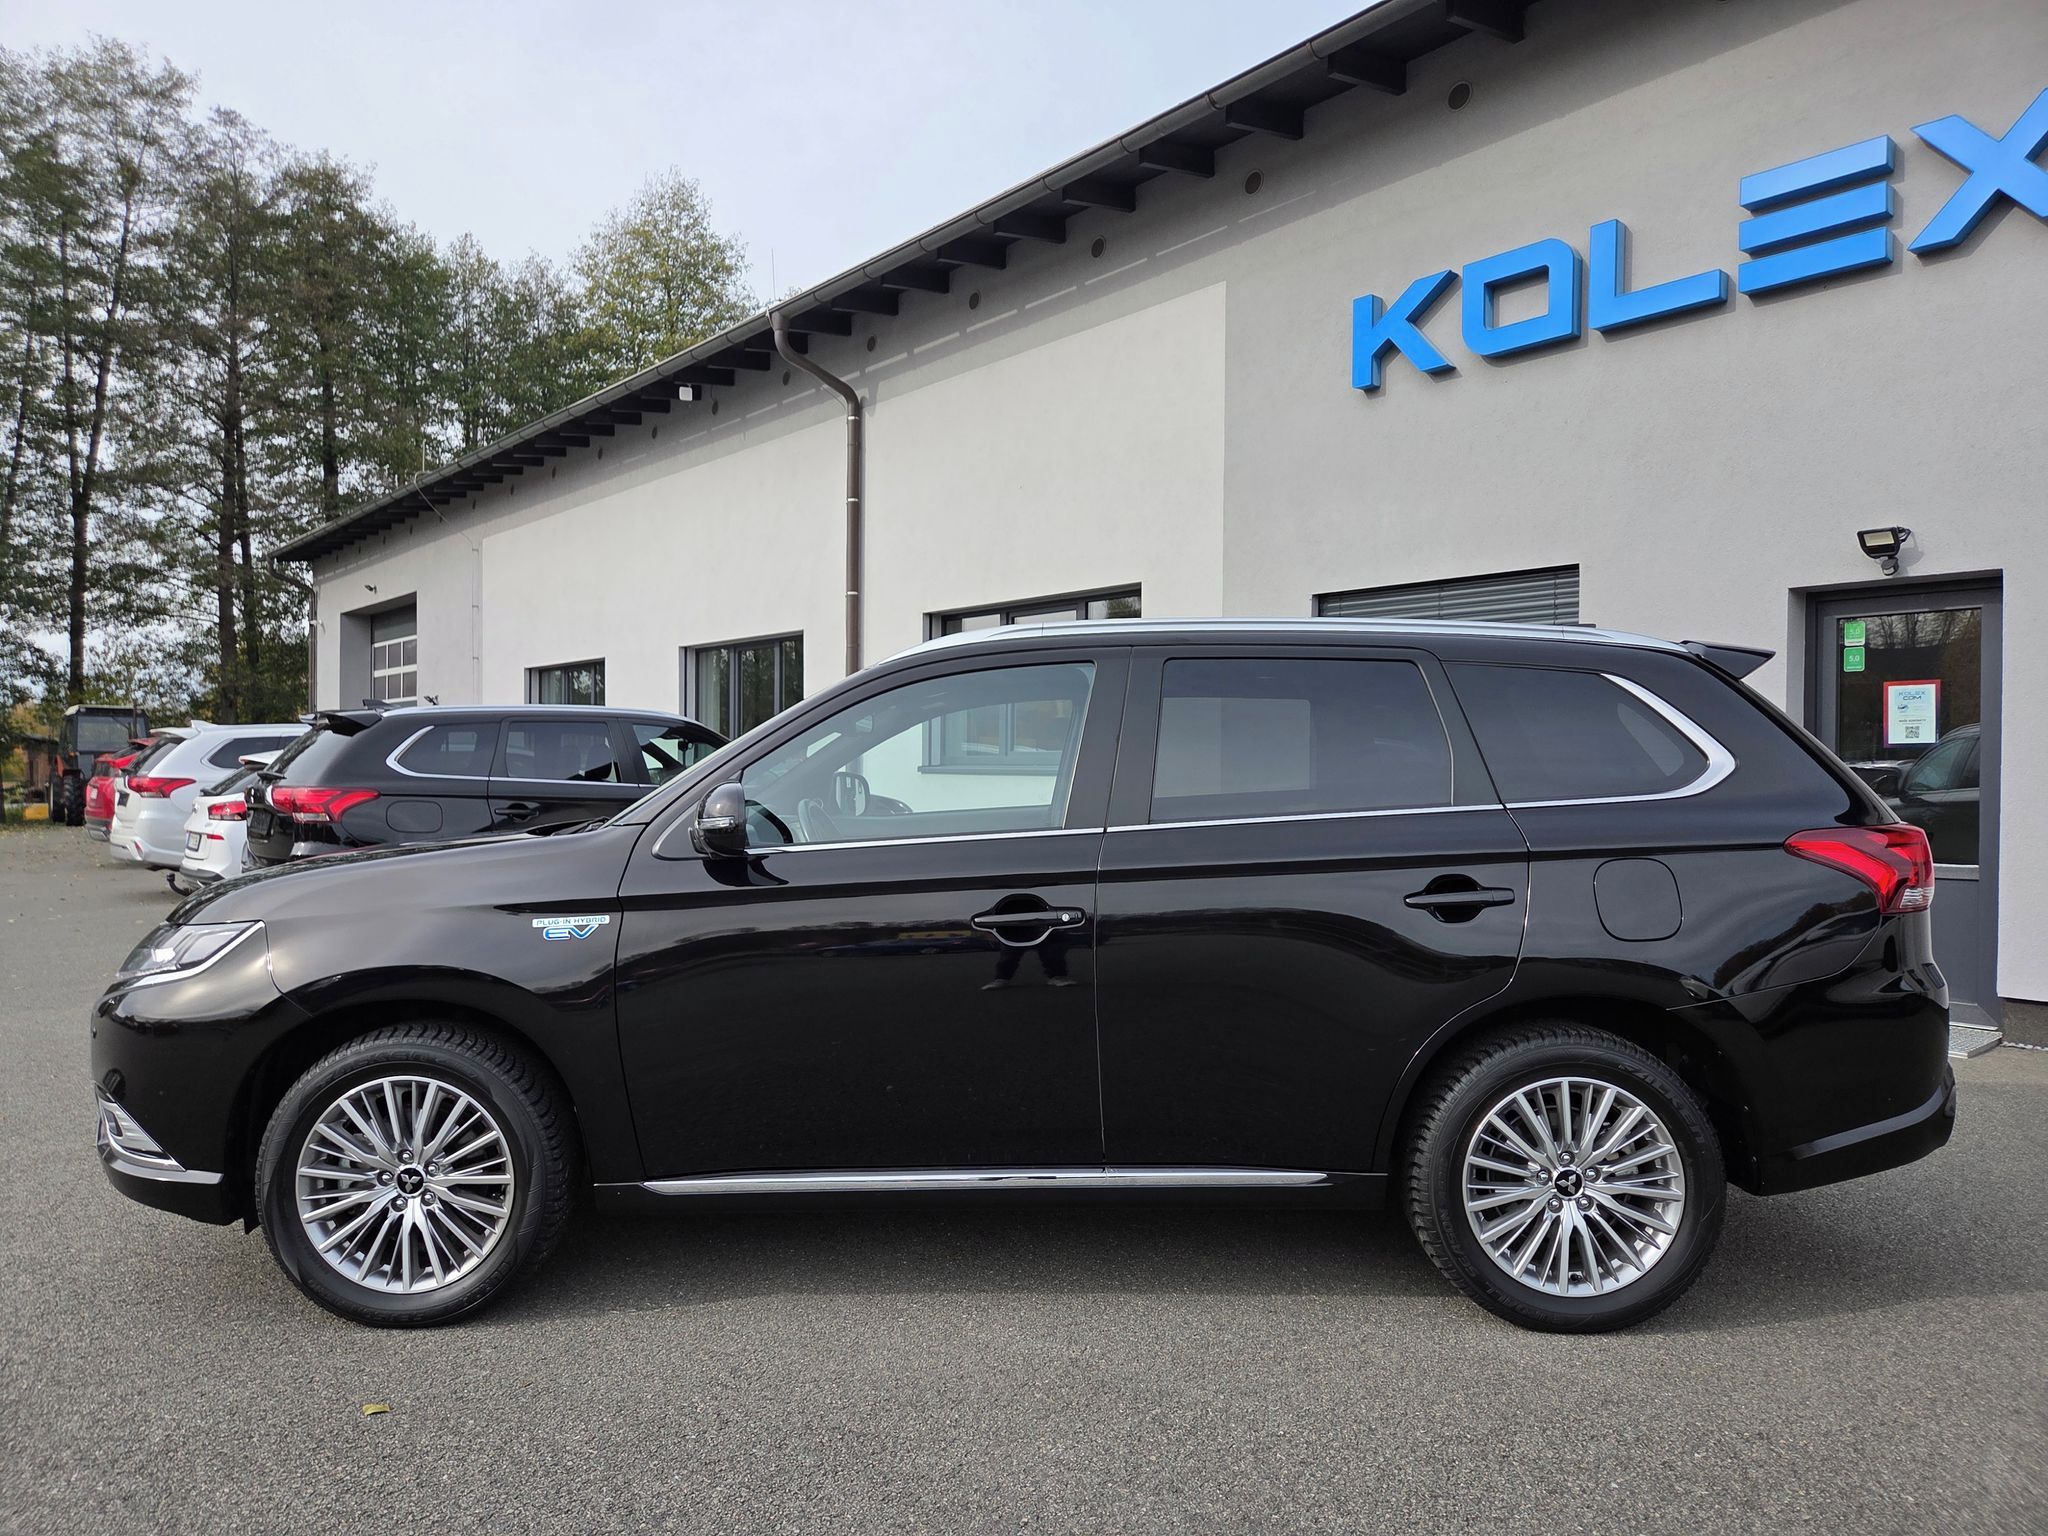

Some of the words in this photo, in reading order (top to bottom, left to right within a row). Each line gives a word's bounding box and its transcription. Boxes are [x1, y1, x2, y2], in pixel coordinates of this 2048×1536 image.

[1351, 87, 2048, 390] KOLEX
[536, 918, 571, 926] PLUG-IN
[573, 916, 607, 924] HYBRID
[543, 925, 600, 940] EV
